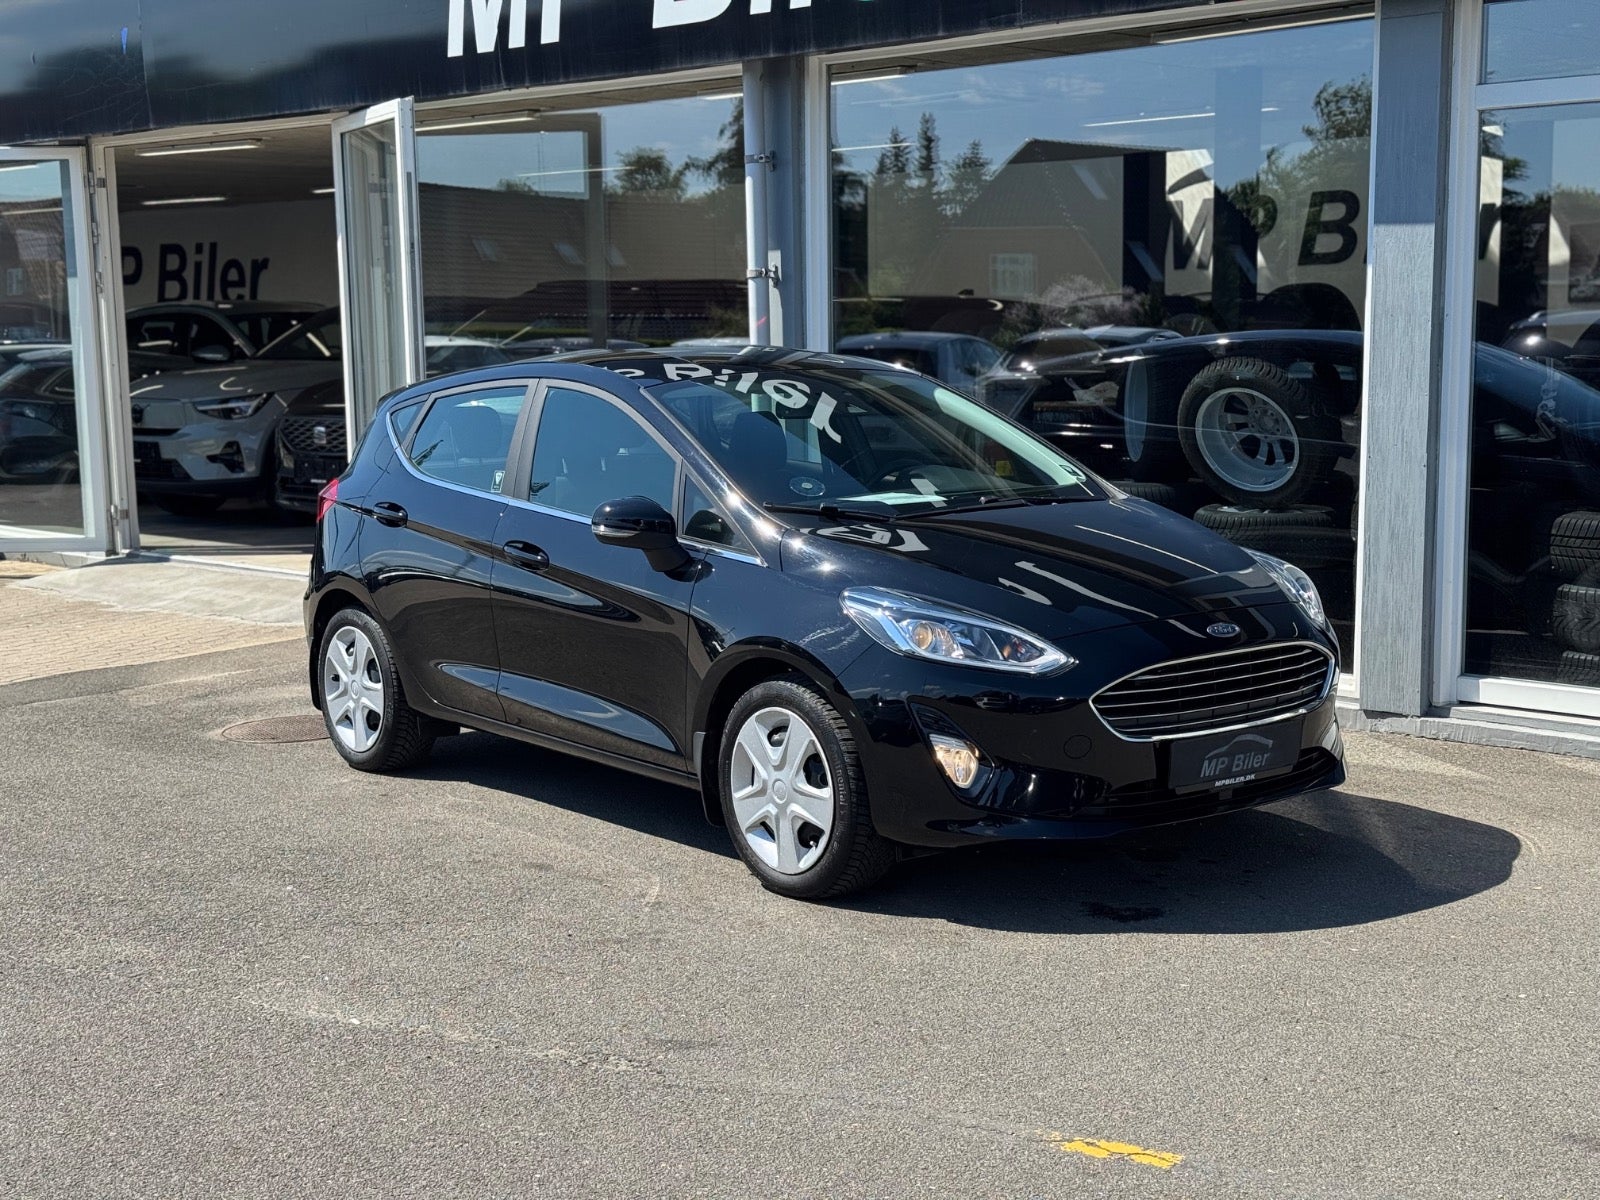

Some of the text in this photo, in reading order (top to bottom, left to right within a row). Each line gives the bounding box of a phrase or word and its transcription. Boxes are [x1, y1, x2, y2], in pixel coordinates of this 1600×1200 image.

[121, 242, 270, 303] P Biler
[1200, 752, 1271, 778] MP Biler
[1214, 773, 1256, 787] MPBILER.DK
